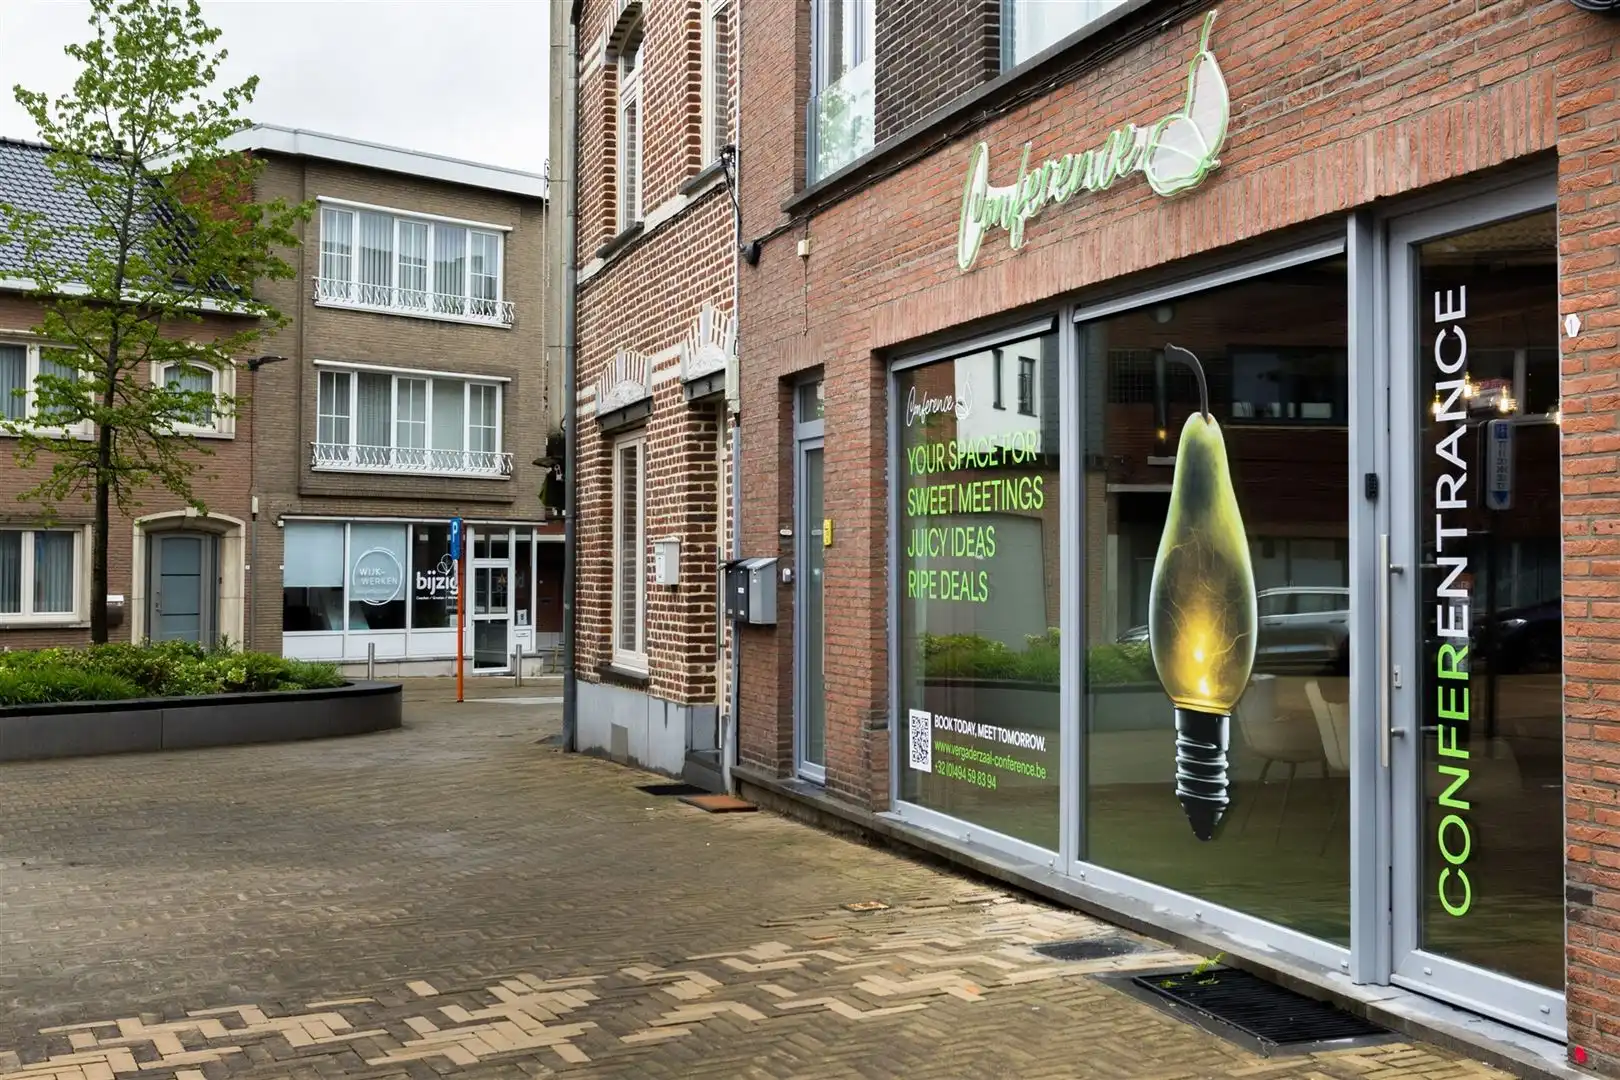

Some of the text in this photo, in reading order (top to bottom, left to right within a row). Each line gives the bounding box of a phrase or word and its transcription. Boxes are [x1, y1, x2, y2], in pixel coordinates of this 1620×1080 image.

[906, 386, 954, 427] Conference
[907, 429, 1037, 476] YOUR SPACE FOR
[907, 475, 1044, 517] SWEET MEETINGS
[452, 522, 459, 544] P
[907, 525, 996, 558] JUICY IDEAS
[359, 567, 386, 576] WIJK-
[361, 577, 398, 585] WERKEN
[908, 570, 988, 602] RIPE DEALS
[1433, 283, 1472, 918] CONFERENTRANCE
[934, 714, 1047, 752] BOOK TODAY, MEET TOMORROW.
[934, 740, 1047, 780] www.vergaderzaal-conference.be
[935, 760, 997, 790] +32 (0)494 59 83 94
